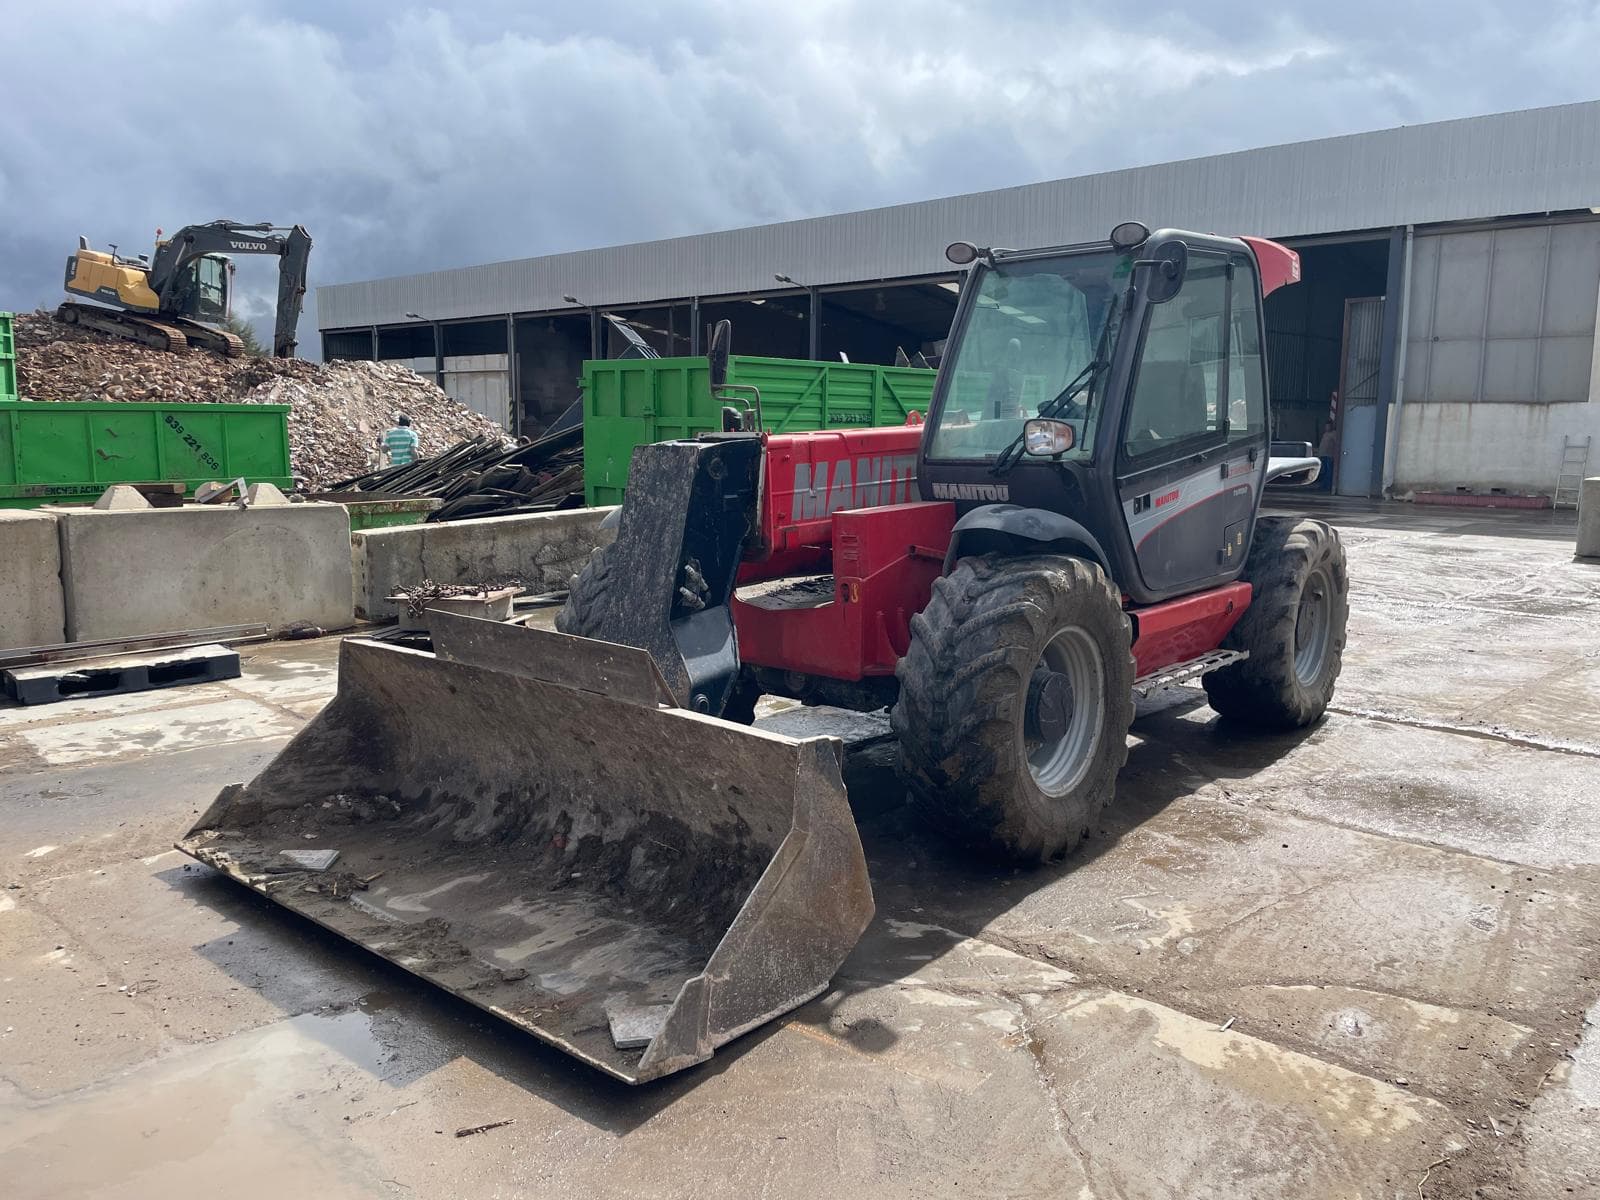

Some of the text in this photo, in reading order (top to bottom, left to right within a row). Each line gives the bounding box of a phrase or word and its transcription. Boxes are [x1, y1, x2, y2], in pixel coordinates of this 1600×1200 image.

[230, 241, 267, 250] VOLVO
[183, 434, 202, 452] 221
[80, 485, 106, 495] ACIMA
[931, 482, 1009, 501] MANITOU
